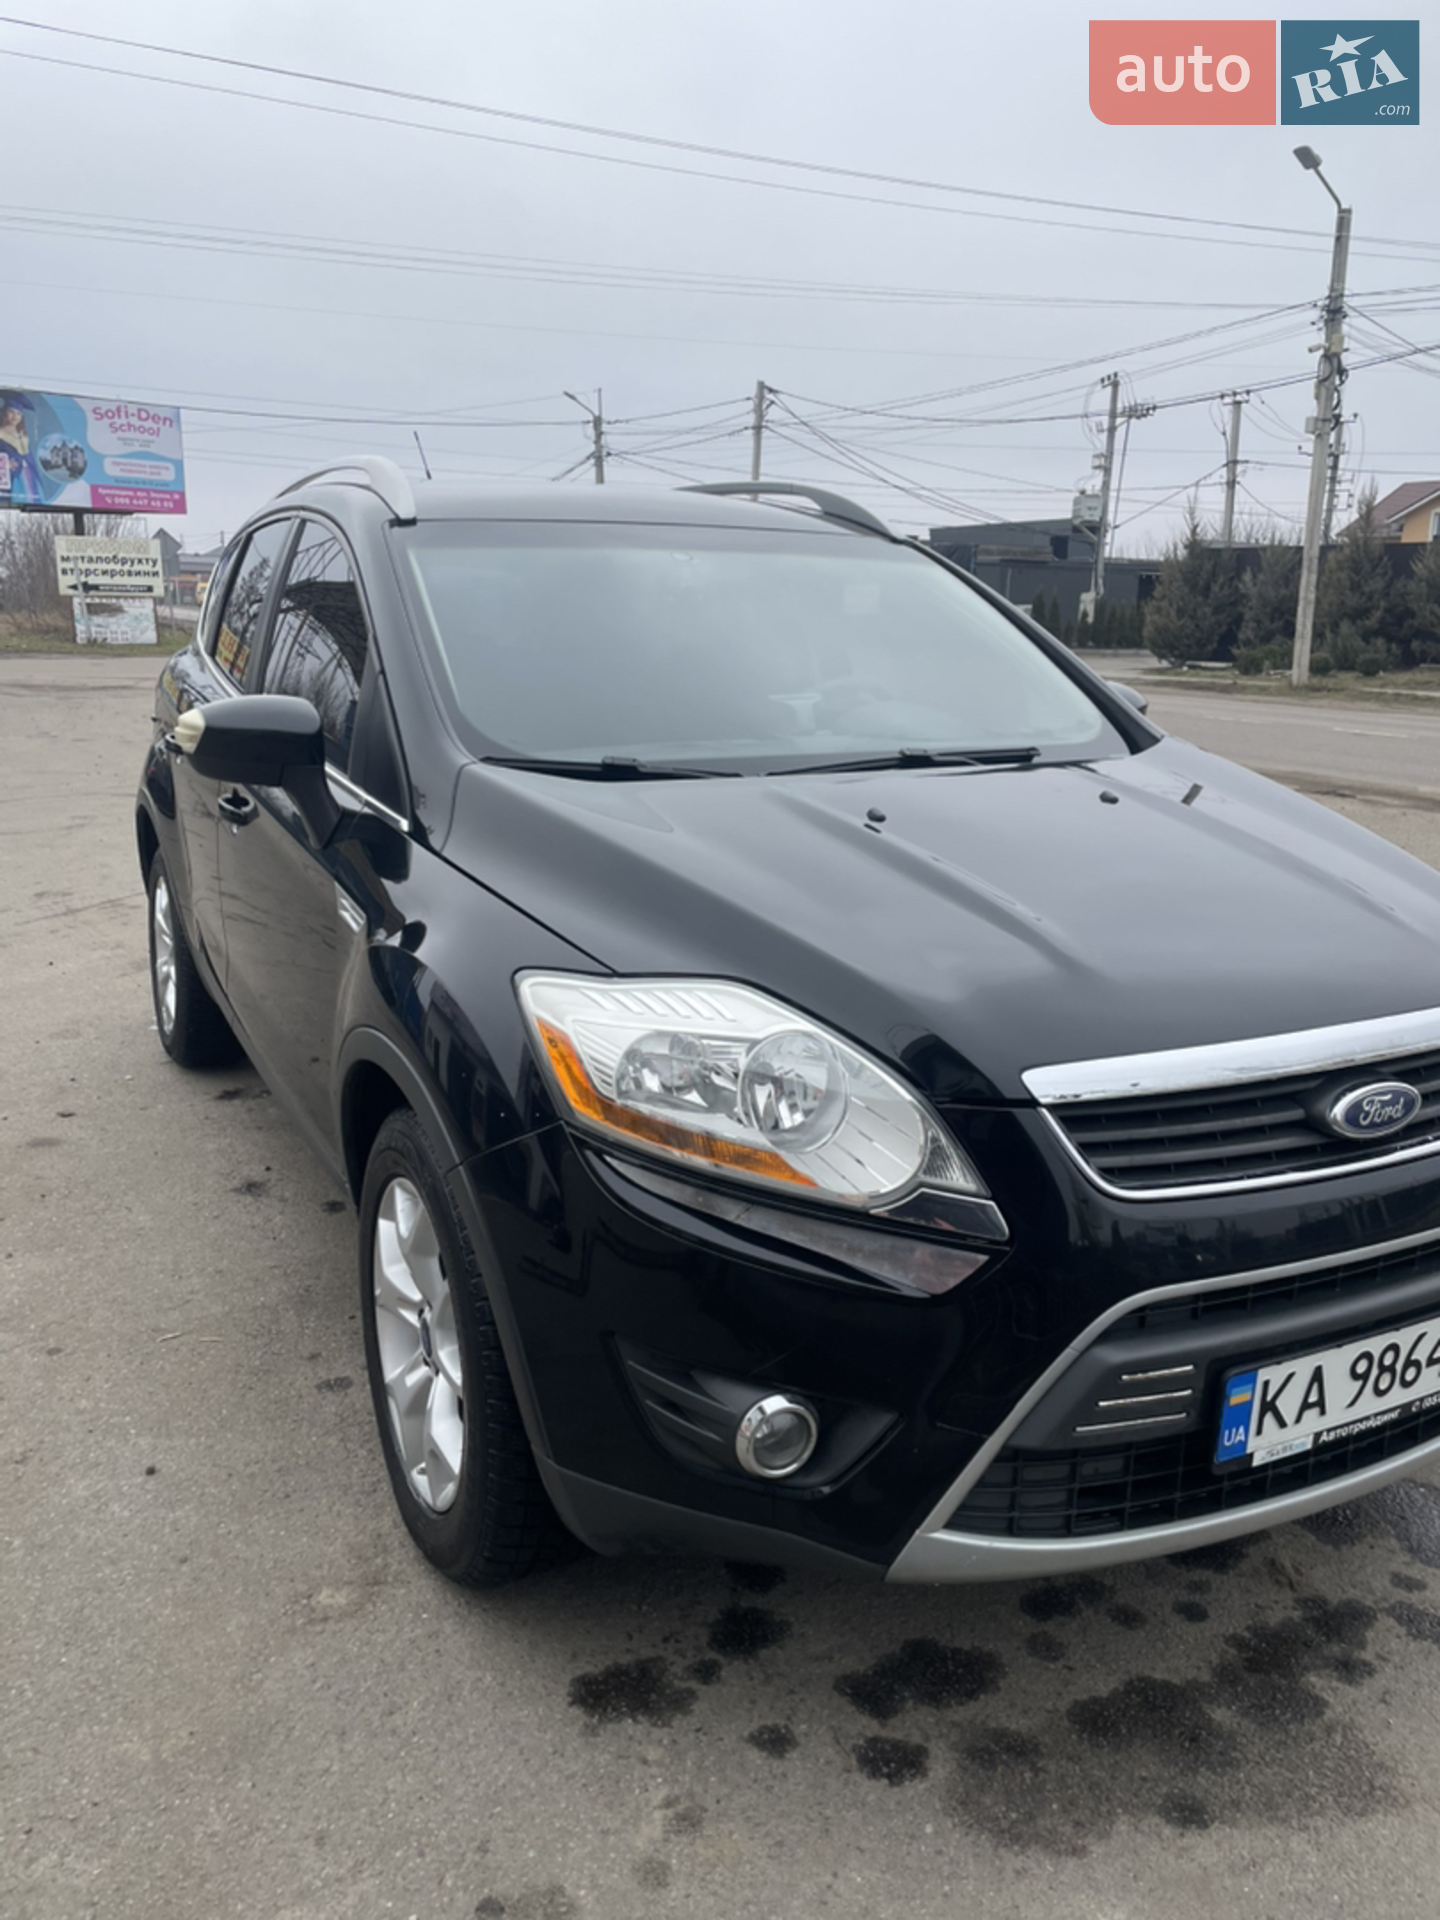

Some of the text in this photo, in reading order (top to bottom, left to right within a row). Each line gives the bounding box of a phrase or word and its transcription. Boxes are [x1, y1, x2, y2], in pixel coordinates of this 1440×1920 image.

[92, 404, 174, 429] Sofi-Den
[108, 421, 161, 438] School
[1358, 1093, 1405, 1127] Ford
[1256, 1365, 1327, 1437] KA
[1223, 1425, 1245, 1446] UA
[1319, 1407, 1402, 1444] Автотрейдинг
